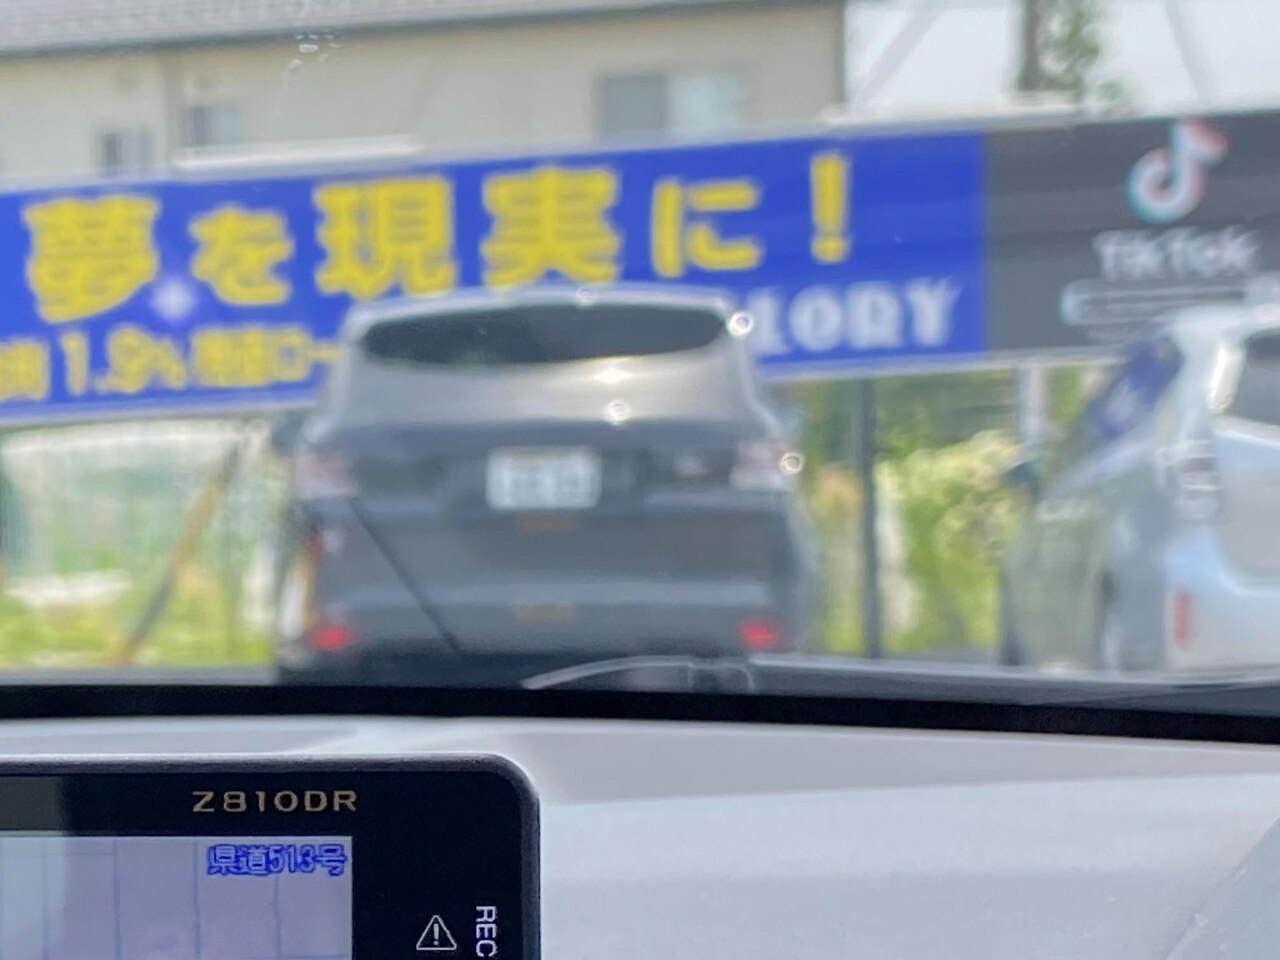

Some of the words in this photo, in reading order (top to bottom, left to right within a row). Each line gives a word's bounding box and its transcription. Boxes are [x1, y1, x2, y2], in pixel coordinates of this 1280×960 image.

[748, 278, 964, 357] LORY
[191, 789, 358, 813] Z810DR
[475, 905, 498, 958] REC
